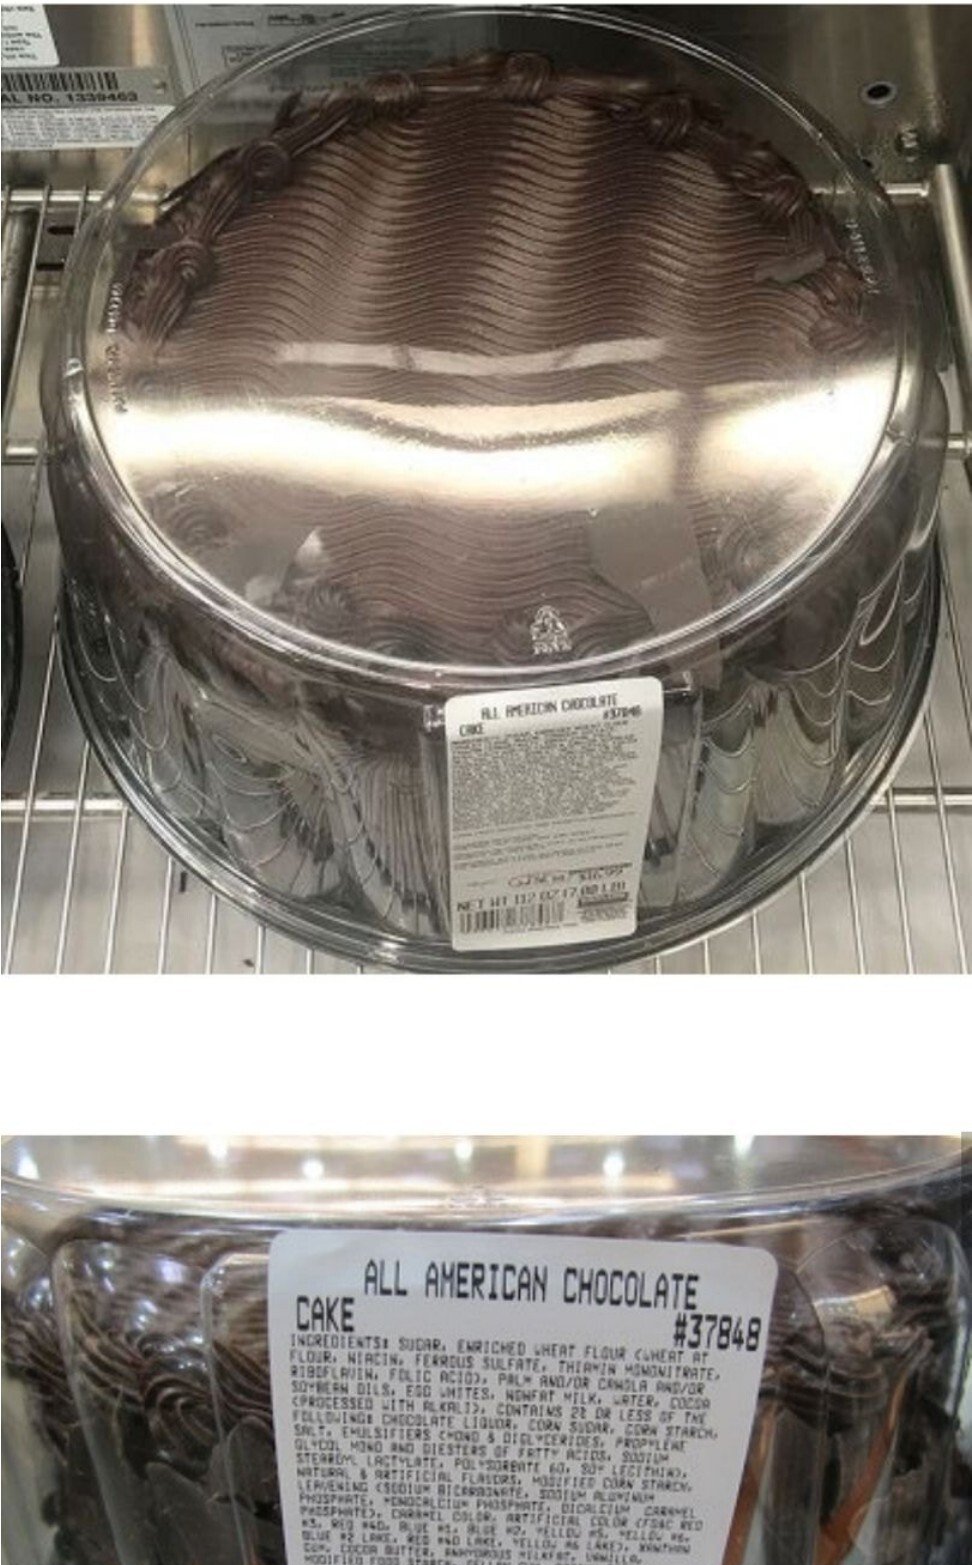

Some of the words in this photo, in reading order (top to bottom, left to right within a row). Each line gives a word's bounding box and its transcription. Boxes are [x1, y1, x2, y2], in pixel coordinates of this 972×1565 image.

[364, 1259, 408, 1297] ALL
[425, 1261, 548, 1302] AMERICAN
[563, 1267, 699, 1310] CHOCOLATE
[296, 1296, 355, 1332] CAKE
[673, 1314, 762, 1352] #37848
